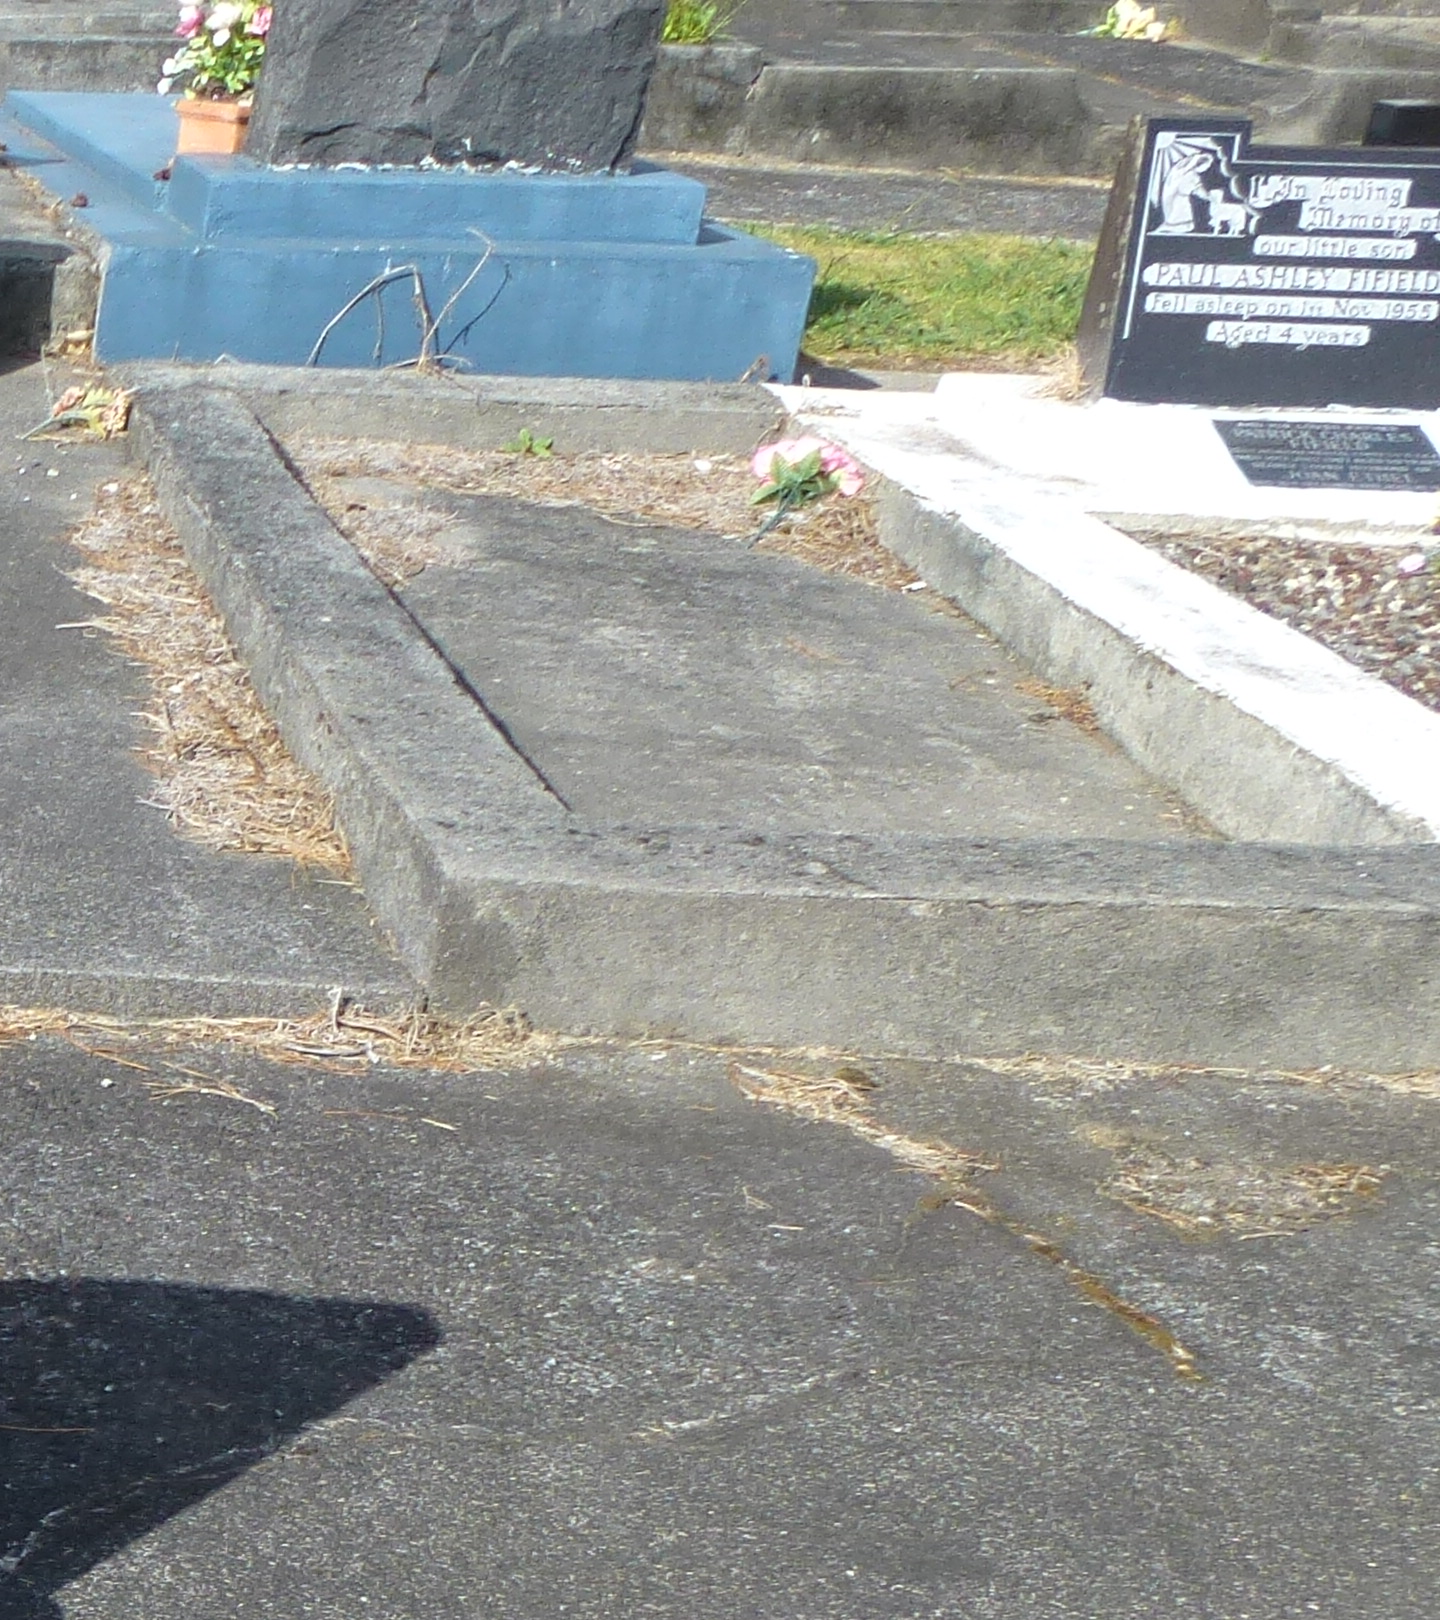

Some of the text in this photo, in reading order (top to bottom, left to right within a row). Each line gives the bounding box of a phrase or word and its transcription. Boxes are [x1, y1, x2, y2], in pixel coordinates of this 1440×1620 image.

[1319, 177, 1403, 208] Loving
[1307, 206, 1412, 238] Memory
[1259, 237, 1407, 258] our little son
[1156, 264, 1440, 292] PAUL ASHLEY FIFIELD
[1151, 294, 1186, 312] Fell
[1195, 296, 1258, 319] asleep
[1265, 302, 1290, 315] on
[1385, 302, 1431, 320] 1955
[1215, 323, 1362, 350] Aged 4 years
